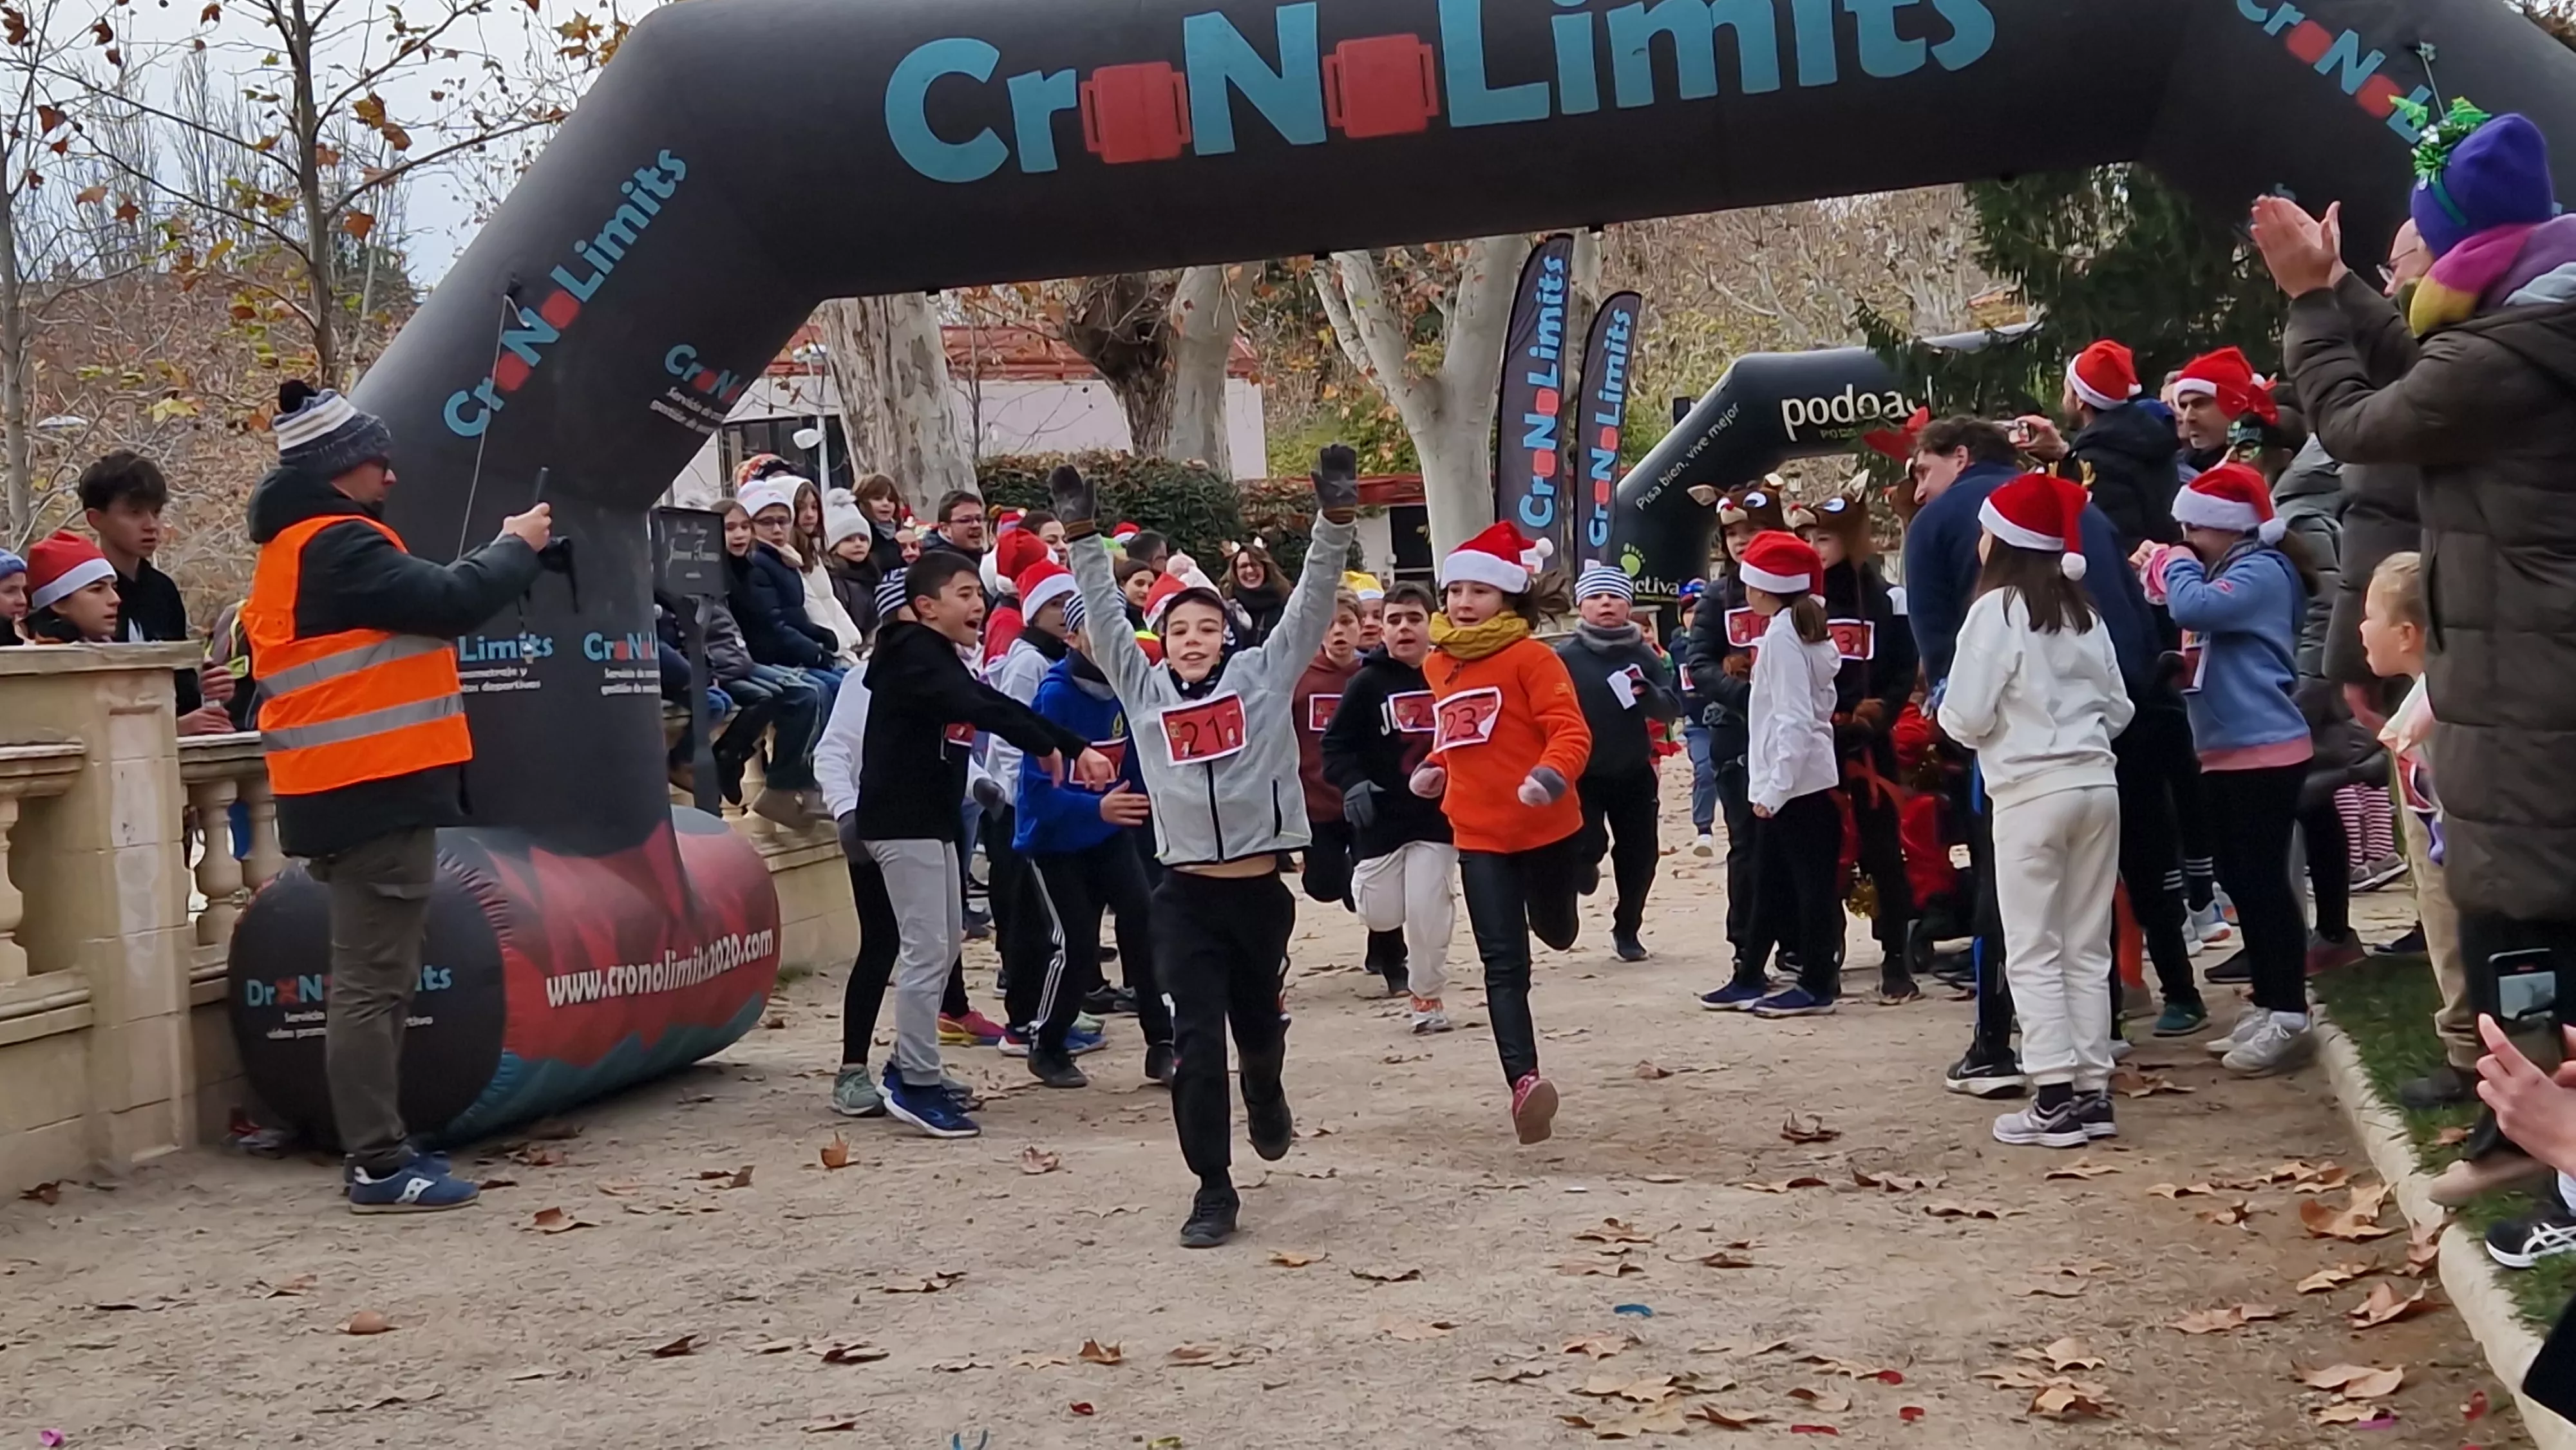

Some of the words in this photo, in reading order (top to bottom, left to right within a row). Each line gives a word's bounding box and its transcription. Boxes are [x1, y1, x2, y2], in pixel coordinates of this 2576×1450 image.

[1636, 485, 1662, 511] Pisa
[1686, 436, 1710, 460] vive
[1708, 401, 1739, 438] mejor
[1180, 713, 1223, 755] 21
[1444, 706, 1479, 742] 23
